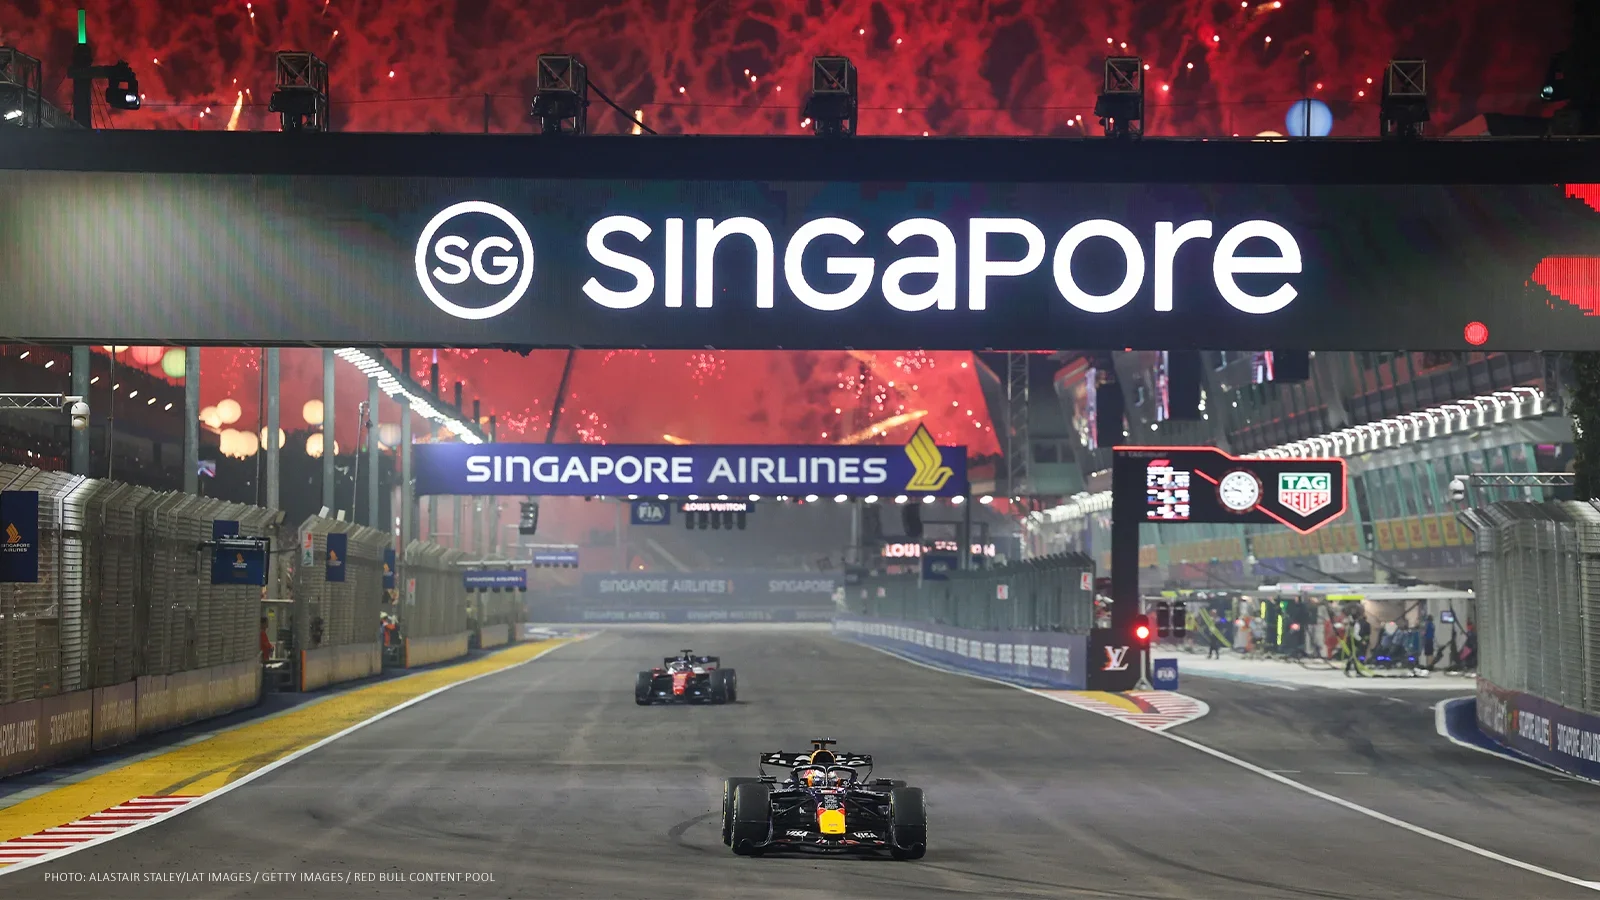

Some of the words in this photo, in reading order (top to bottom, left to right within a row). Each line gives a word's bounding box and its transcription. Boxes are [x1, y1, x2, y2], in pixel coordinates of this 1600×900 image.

[432, 235, 520, 285] SG
[466, 456, 693, 483] SINGAPORE
[708, 457, 887, 484] AIRLINES
[1282, 477, 1327, 488] TAG
[683, 503, 710, 512] LOUIS
[711, 503, 747, 512] VUITTON
[1282, 492, 1328, 513] HEUER
[638, 506, 663, 518] FIA
[600, 580, 668, 593] SINGAPORE
[672, 580, 726, 593] AIRLINES
[1157, 669, 1174, 679] FIA
